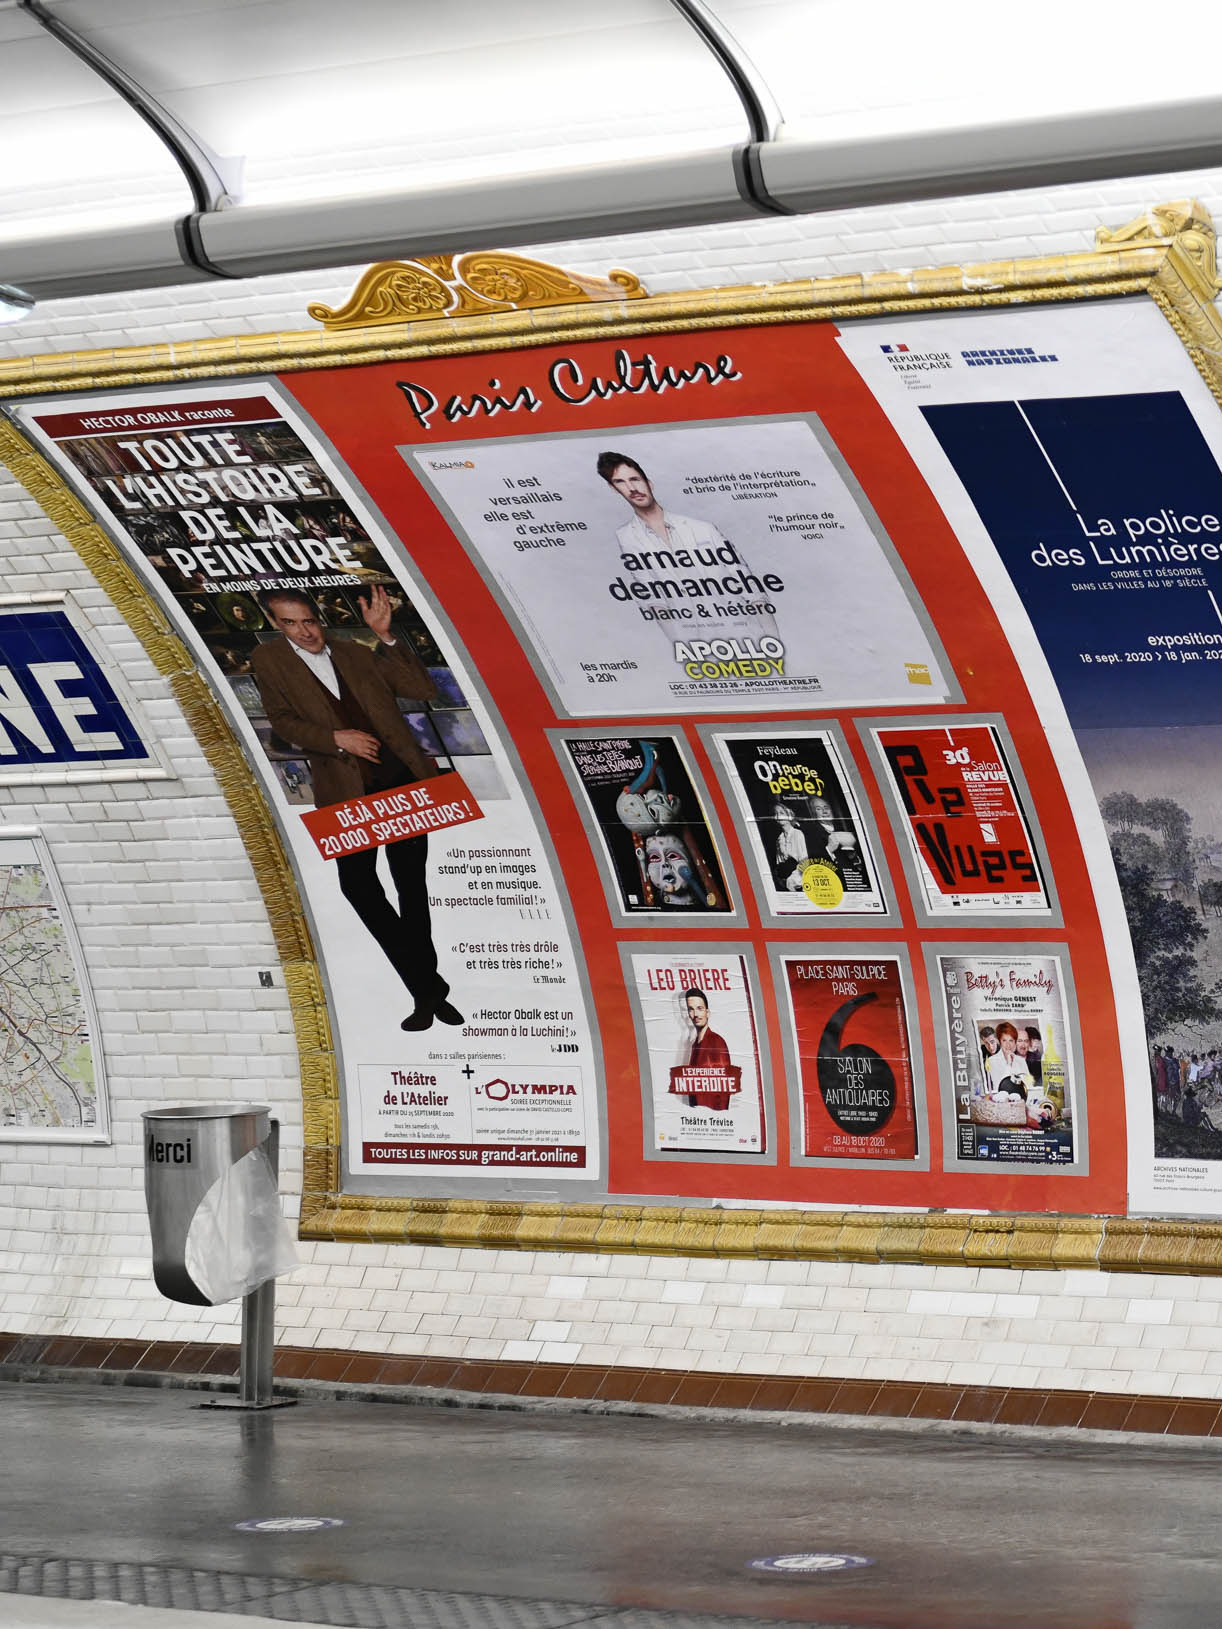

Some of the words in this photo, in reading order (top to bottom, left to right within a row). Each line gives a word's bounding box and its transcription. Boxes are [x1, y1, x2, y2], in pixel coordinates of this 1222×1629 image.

[887, 352, 952, 364] RÉPUBLIQUE
[961, 347, 1035, 359] ARCHIVES
[892, 361, 953, 372] FRANÇAISE
[965, 355, 1060, 367] NATIONALES
[396, 378, 542, 429] Paris
[548, 349, 743, 406] Culture
[80, 414, 137, 430] HECTOR
[140, 409, 183, 425] OBALK
[184, 406, 235, 421] raconte
[117, 432, 253, 472] TOUTE
[503, 477, 515, 489] il
[516, 475, 542, 489] est
[738, 470, 753, 481] de
[754, 469, 801, 481] l'écriture
[105, 464, 322, 510] L'HISTOIRE
[682, 486, 695, 496] et
[696, 483, 718, 494] brio
[718, 482, 732, 493] de
[488, 490, 563, 507] versaillais
[179, 507, 242, 541] DE
[236, 503, 300, 538] LA
[483, 508, 510, 523] elle
[511, 509, 535, 522] est
[785, 512, 820, 525] prince
[820, 510, 835, 521] de
[515, 519, 588, 537] d'extrême
[768, 522, 817, 534] l'humour
[1076, 513, 1117, 537] La
[1123, 509, 1221, 542] police
[512, 534, 567, 552] gauche
[801, 533, 825, 541] VOICI
[166, 536, 364, 579] PEINTURE
[620, 540, 741, 573] arnaud
[1030, 543, 1086, 568] des
[1110, 570, 1142, 579] ORDRE
[1142, 569, 1153, 578] ET
[1155, 567, 1204, 578] DÉSORDRE
[202, 581, 222, 594] EN
[222, 578, 262, 593] MOINS
[262, 578, 281, 591] DE
[281, 577, 312, 590] DEUX
[313, 574, 362, 588] HEURES
[608, 569, 785, 603] demanche
[1071, 582, 1096, 591] DANS
[1098, 582, 1114, 591] LES
[1115, 581, 1145, 590] VILLES
[1147, 580, 1160, 589] AU
[1176, 577, 1209, 587] SIÈCLE
[639, 605, 694, 622] blanc
[697, 603, 714, 620] &
[716, 599, 777, 618] hétéro
[674, 636, 785, 663] APOLLO
[1079, 653, 1093, 664] 18
[1095, 652, 1123, 665] sept.
[1125, 651, 1153, 663] 2020
[1164, 650, 1178, 661] 18
[1180, 650, 1203, 664] jan.
[580, 660, 598, 672] les
[599, 659, 638, 671] mardis
[685, 659, 786, 680] COMEDY
[588, 673, 595, 683] à
[595, 673, 618, 683] 20h
[744, 678, 820, 688] APOLLOTHEATRE.FR
[577, 741, 596, 751] HALLE
[595, 740, 612, 751] SAINT
[756, 745, 798, 758] Feydeau
[575, 755, 594, 766] DANS
[606, 755, 643, 773] BLANQUET
[971, 760, 1001, 772] Salon
[753, 760, 783, 782] On
[782, 764, 819, 778] purge
[962, 771, 1010, 782] REVUE
[335, 800, 376, 828] DÉJÀ
[372, 793, 412, 818] PLUS
[410, 787, 435, 808] DE
[371, 801, 465, 842] SPECTATEURS
[468, 847, 532, 860] passionnant
[438, 863, 483, 876] stand'up
[485, 865, 497, 874] en
[499, 863, 537, 876] images
[468, 881, 479, 890] et
[481, 881, 494, 890] en
[495, 879, 542, 891] musique.
[429, 896, 442, 907] Un
[444, 895, 494, 908] spectacle
[488, 941, 509, 953] très
[511, 941, 531, 953] très
[533, 941, 559, 953] drôle
[466, 960, 477, 970] et
[479, 958, 499, 969] très
[502, 958, 522, 969] très
[540, 975, 566, 984] Monde
[647, 968, 676, 991] LEO
[678, 968, 732, 991] BRIERE
[796, 965, 827, 980] PLACE
[826, 965, 888, 980] SAINT-SULPICE
[831, 981, 858, 996] PARIS
[964, 970, 1005, 997] Betty's
[1009, 969, 1054, 996] Family
[480, 1009, 512, 1020] Hector
[514, 1009, 542, 1020] Obalk
[543, 1011, 559, 1020] est
[561, 1012, 573, 1020] un
[462, 1026, 509, 1037] showman
[511, 1026, 517, 1037] à
[519, 1026, 529, 1037] la
[951, 995, 969, 1087] Bruyère
[428, 1051, 444, 1060] dans
[449, 1051, 466, 1060] salles
[682, 1067, 726, 1077] L'EXPERIENCE
[837, 1057, 873, 1075] SALON
[391, 1070, 437, 1086] Théâtre
[674, 1076, 737, 1094] INTERDITE
[847, 1074, 865, 1089] DES
[474, 1078, 578, 1102] L'OLYMPIA
[825, 1088, 890, 1107] ANTIQUAIRES
[383, 1091, 398, 1106] de
[400, 1091, 449, 1107] L'Atelier
[529, 1098, 572, 1106] EXCEPTIONNELLE
[958, 1093, 971, 1120] La
[680, 1116, 708, 1126] Théâtre
[709, 1117, 734, 1127] Trévise
[370, 1148, 408, 1159] TOUTES
[410, 1149, 426, 1159] LES
[428, 1149, 457, 1160] INFOS
[459, 1149, 478, 1161] SUR
[481, 1147, 579, 1164] grand-art.online
